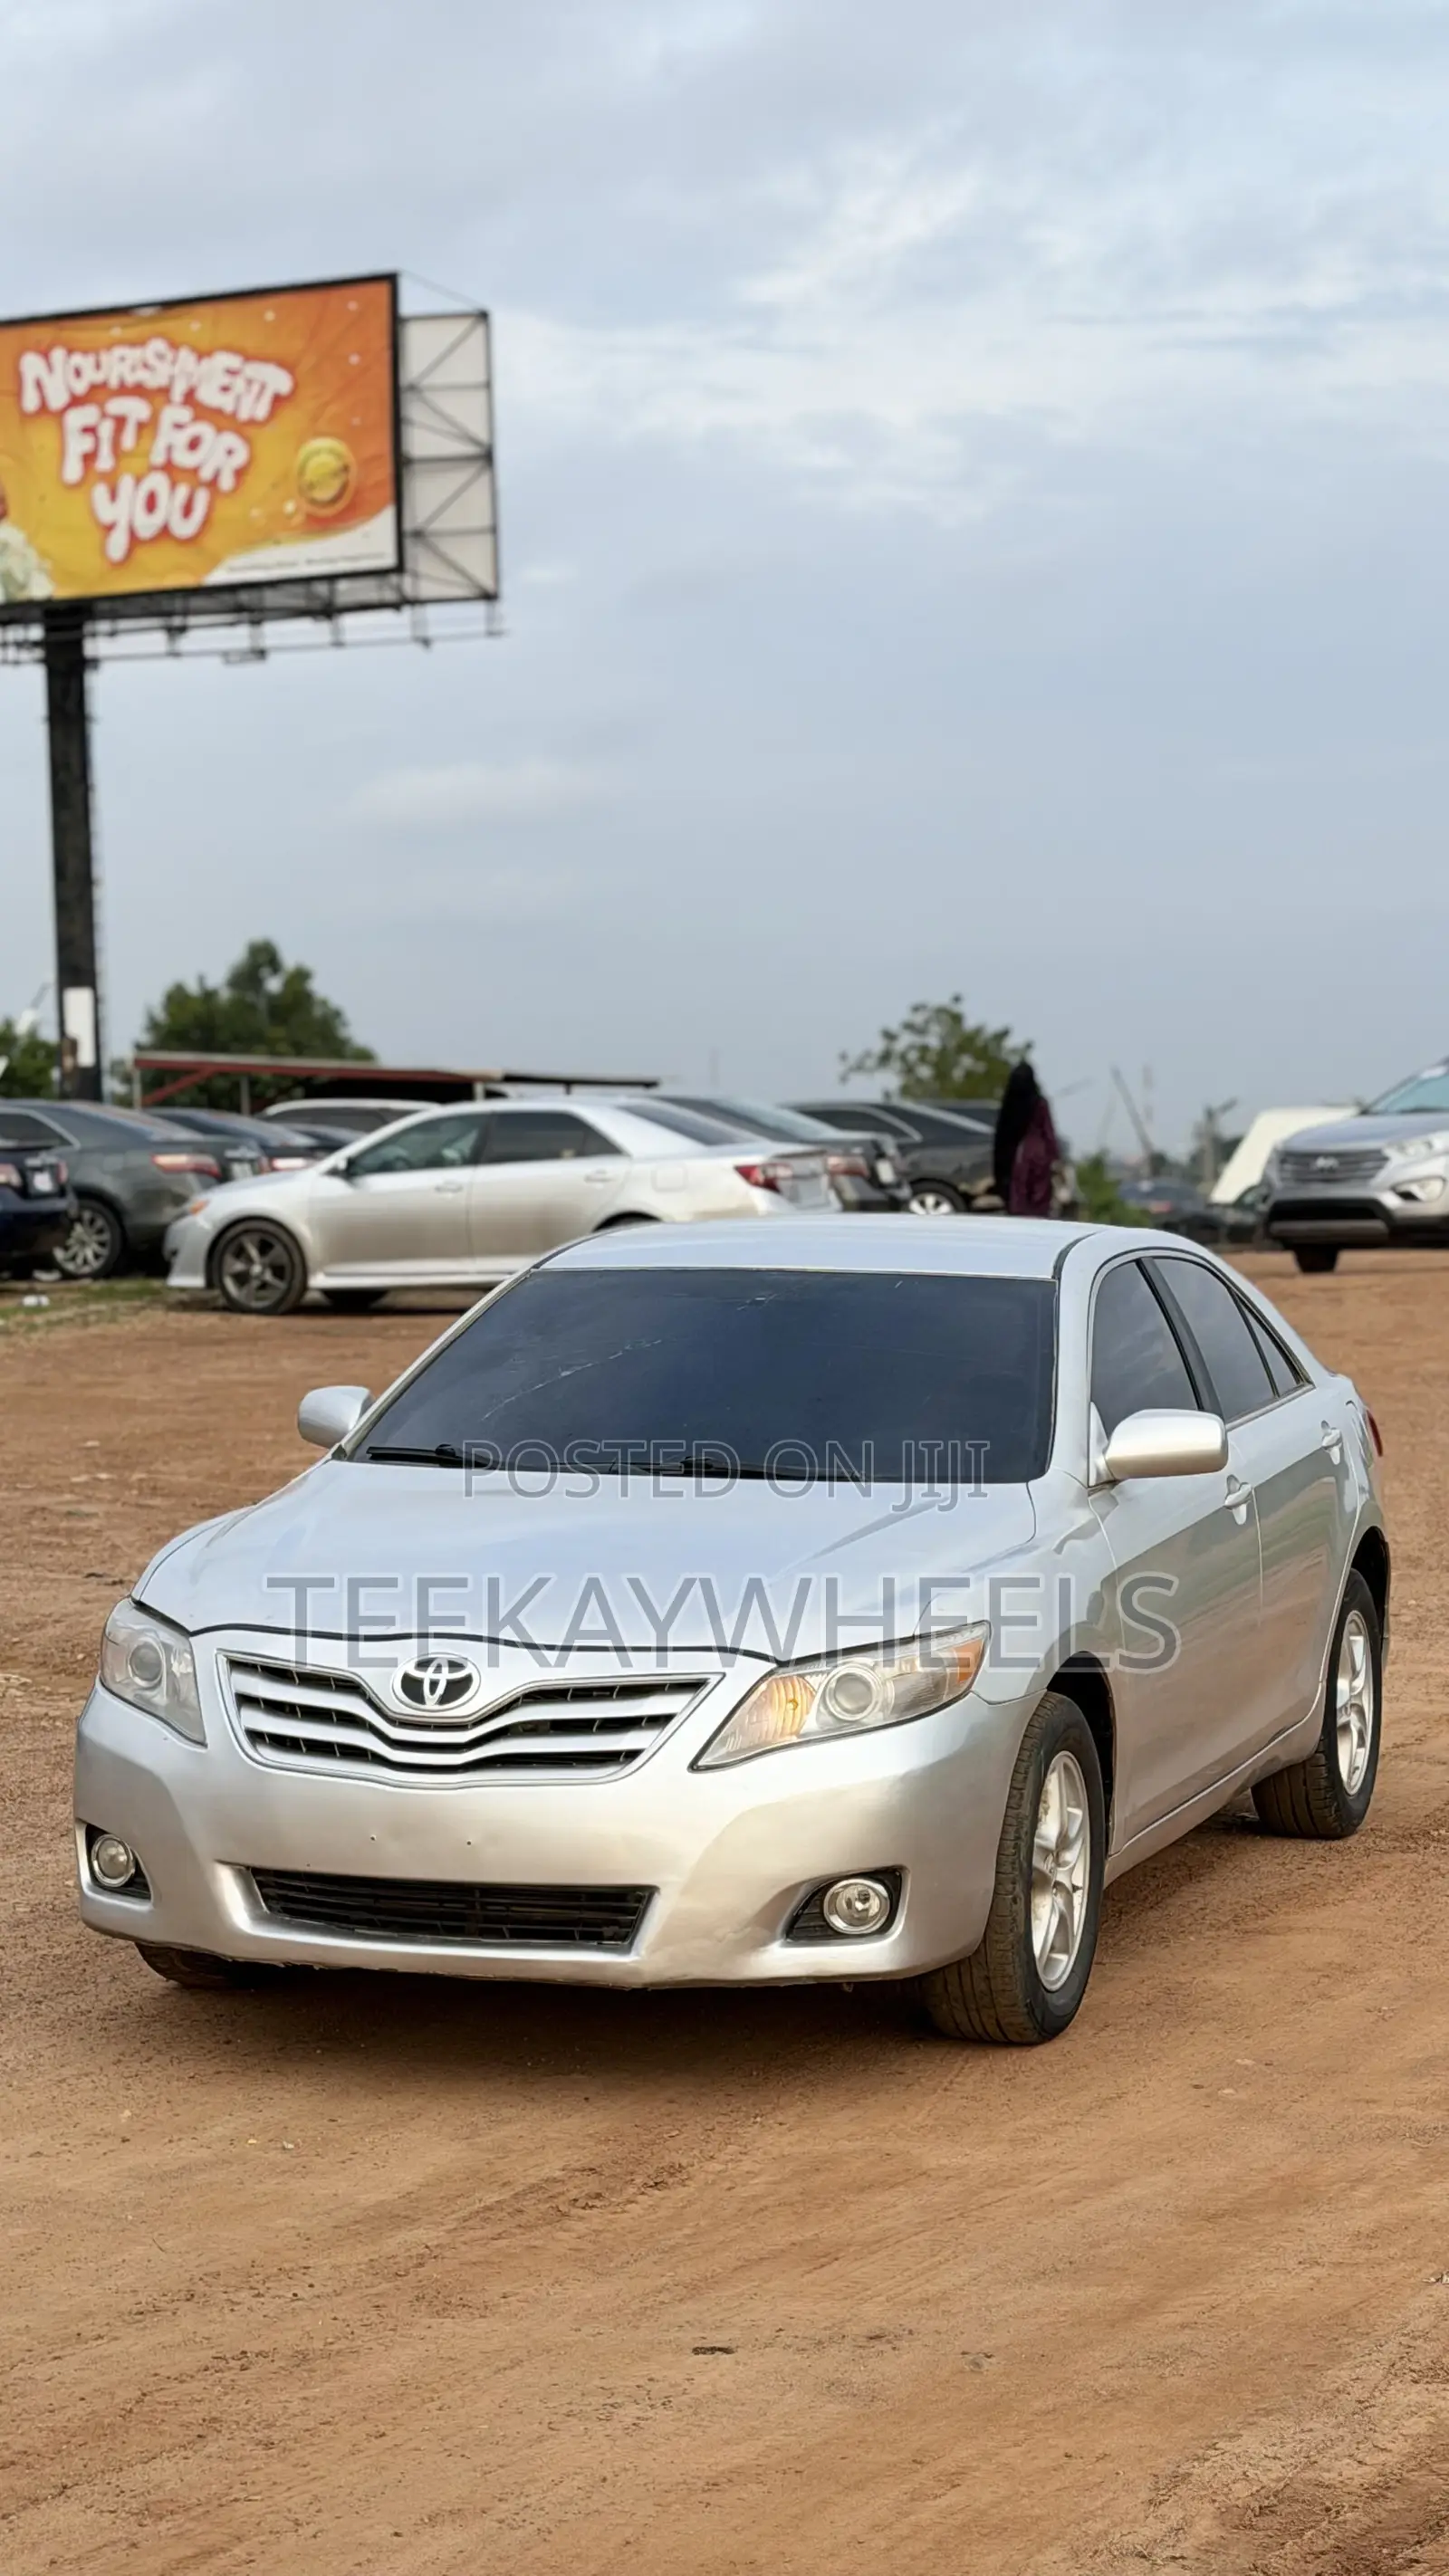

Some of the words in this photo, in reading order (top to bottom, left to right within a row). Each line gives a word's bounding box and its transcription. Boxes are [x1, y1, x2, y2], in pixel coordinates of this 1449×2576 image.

[62, 396, 152, 484] FIT
[149, 406, 250, 493] FOR
[91, 469, 210, 563] YOU
